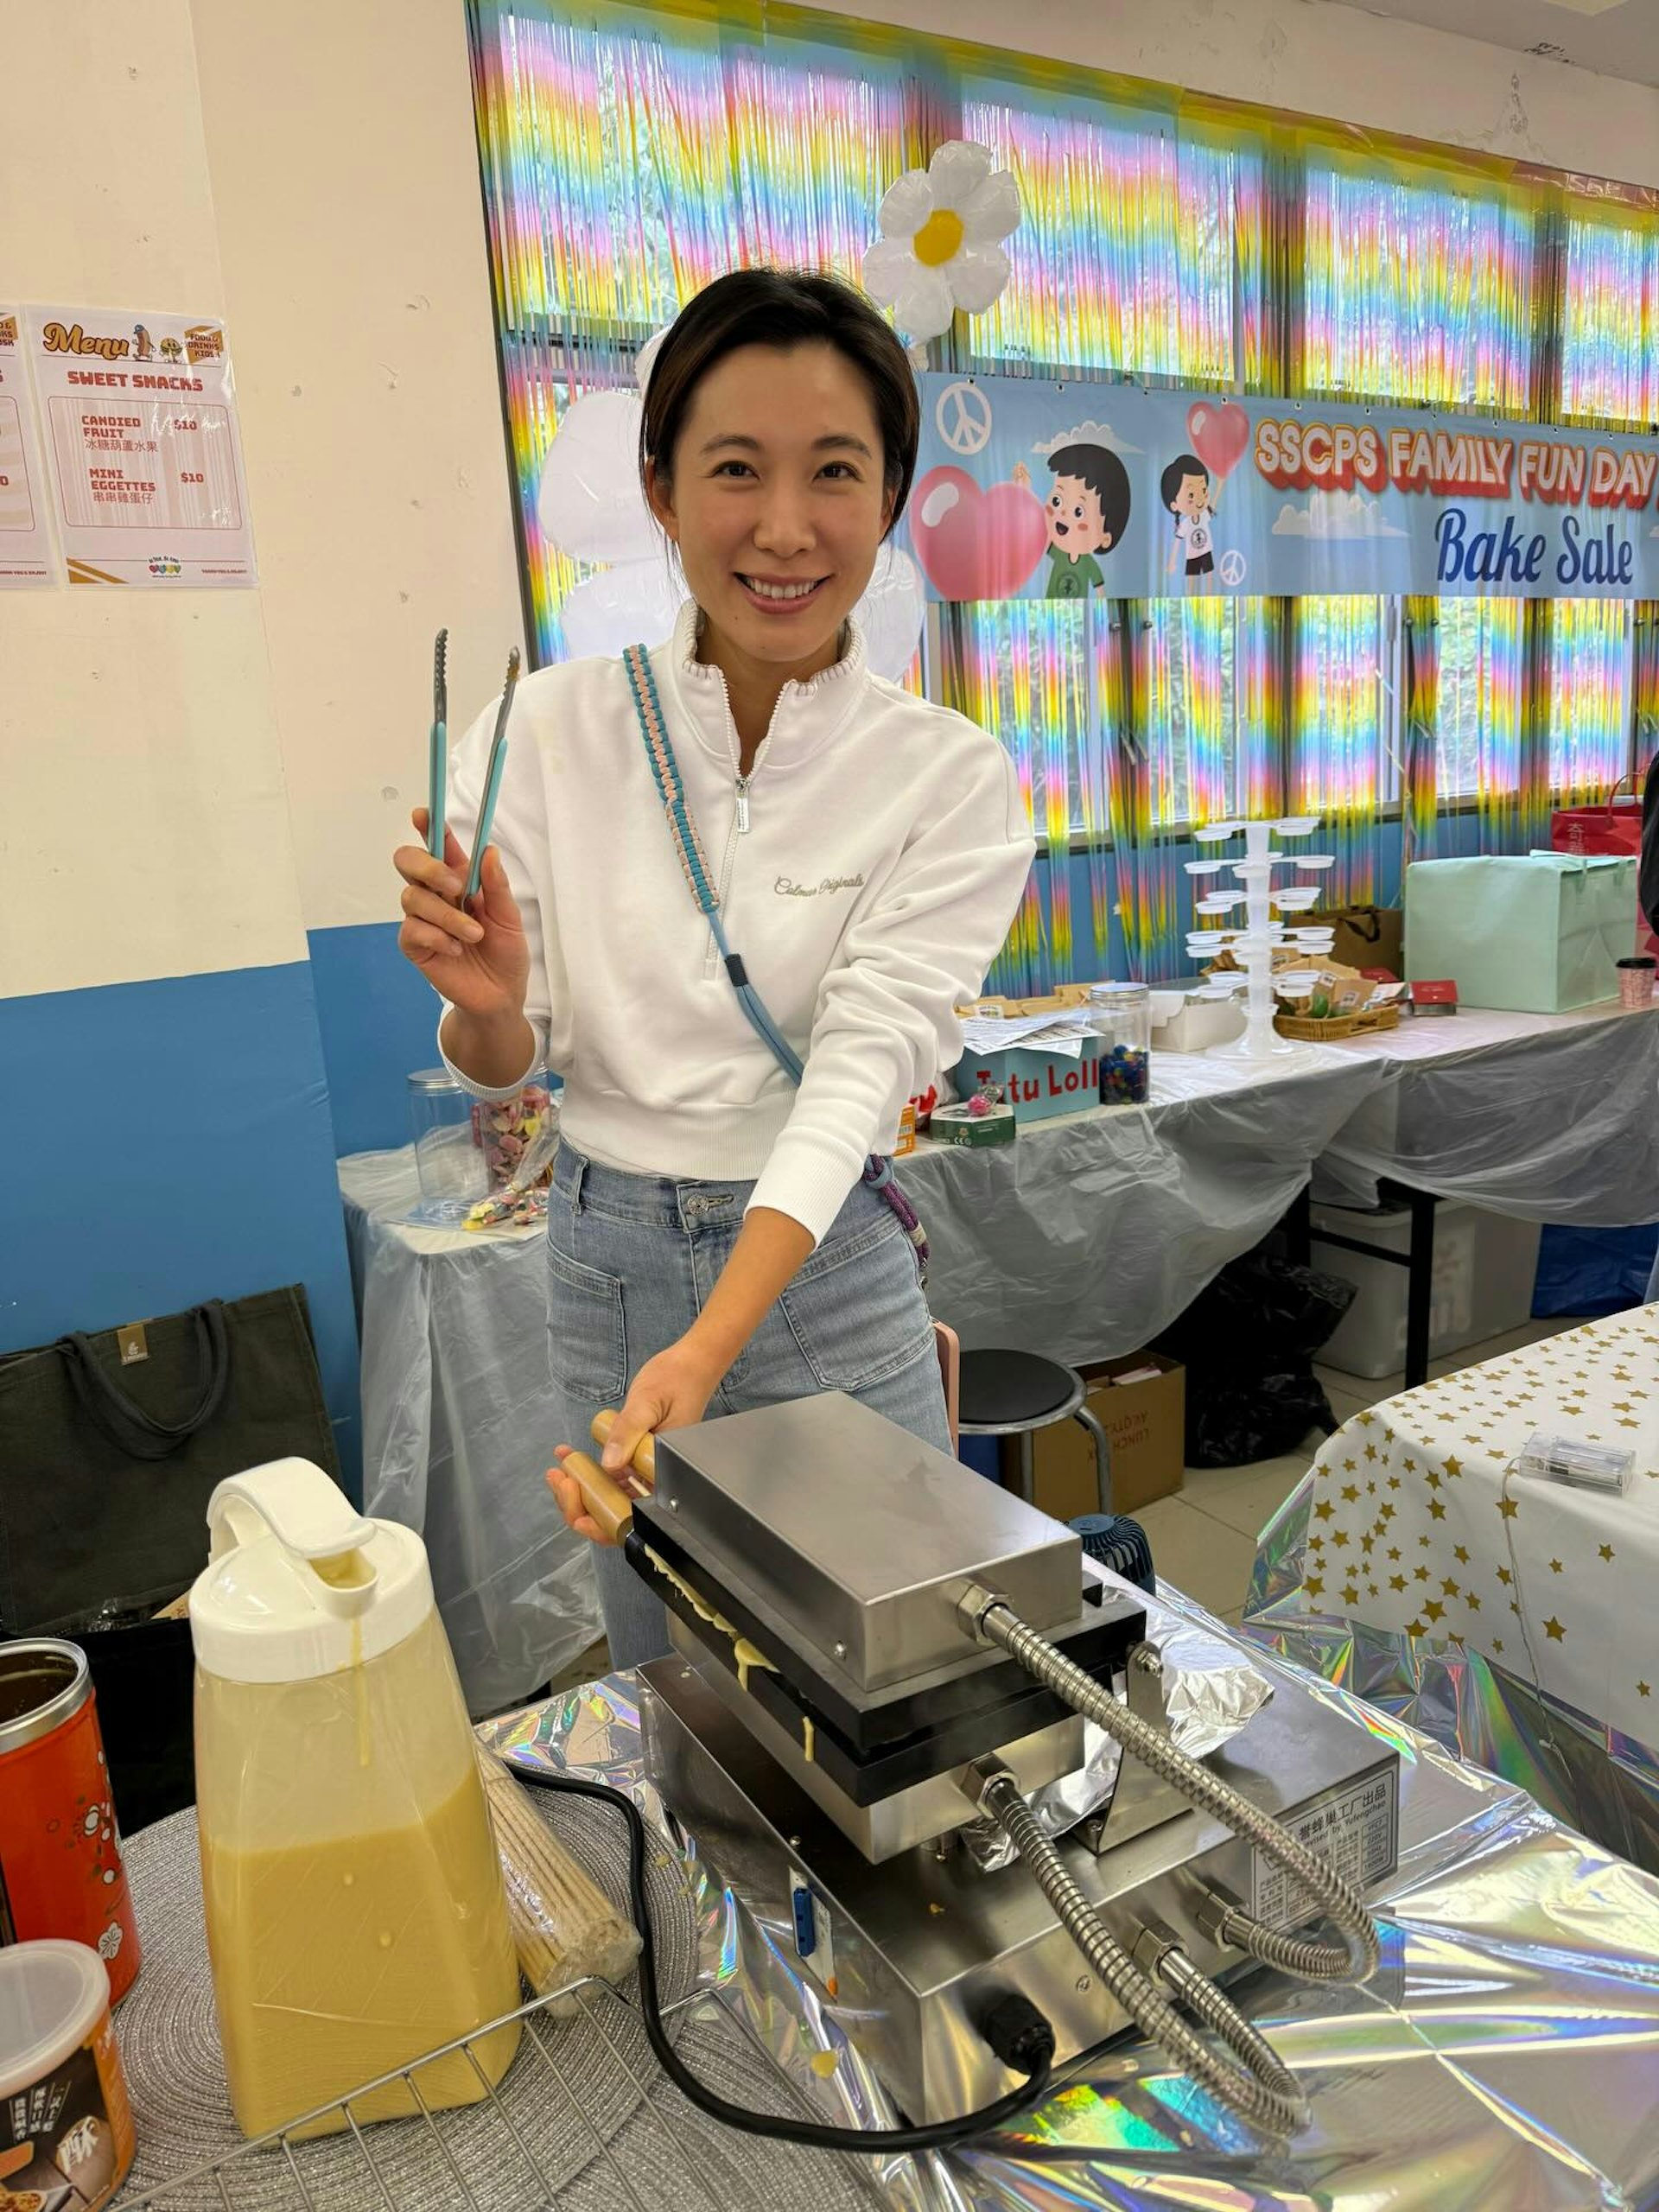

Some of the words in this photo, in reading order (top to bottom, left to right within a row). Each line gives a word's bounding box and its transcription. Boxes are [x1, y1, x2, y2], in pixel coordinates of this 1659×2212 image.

[43, 322, 130, 360] Menu
[67, 371, 128, 387] SWEET
[132, 374, 203, 391] SNACKS
[81, 416, 141, 427] CANDIED
[174, 419, 197, 430] $10
[83, 428, 124, 438] FRUIT
[1255, 420, 1384, 493] SSCPS
[1389, 429, 1514, 498] FAMILY
[1519, 443, 1584, 505] FUN
[1589, 447, 1657, 508] DAY
[89, 468, 124, 479] MINI
[181, 472, 204, 483] $10
[91, 480, 156, 492] EGGETTES
[1434, 508, 1547, 584] Bake
[1556, 516, 1632, 585] Sale
[976, 1070, 1039, 1104] Ttu
[1047, 1058, 1098, 1097] Loll
